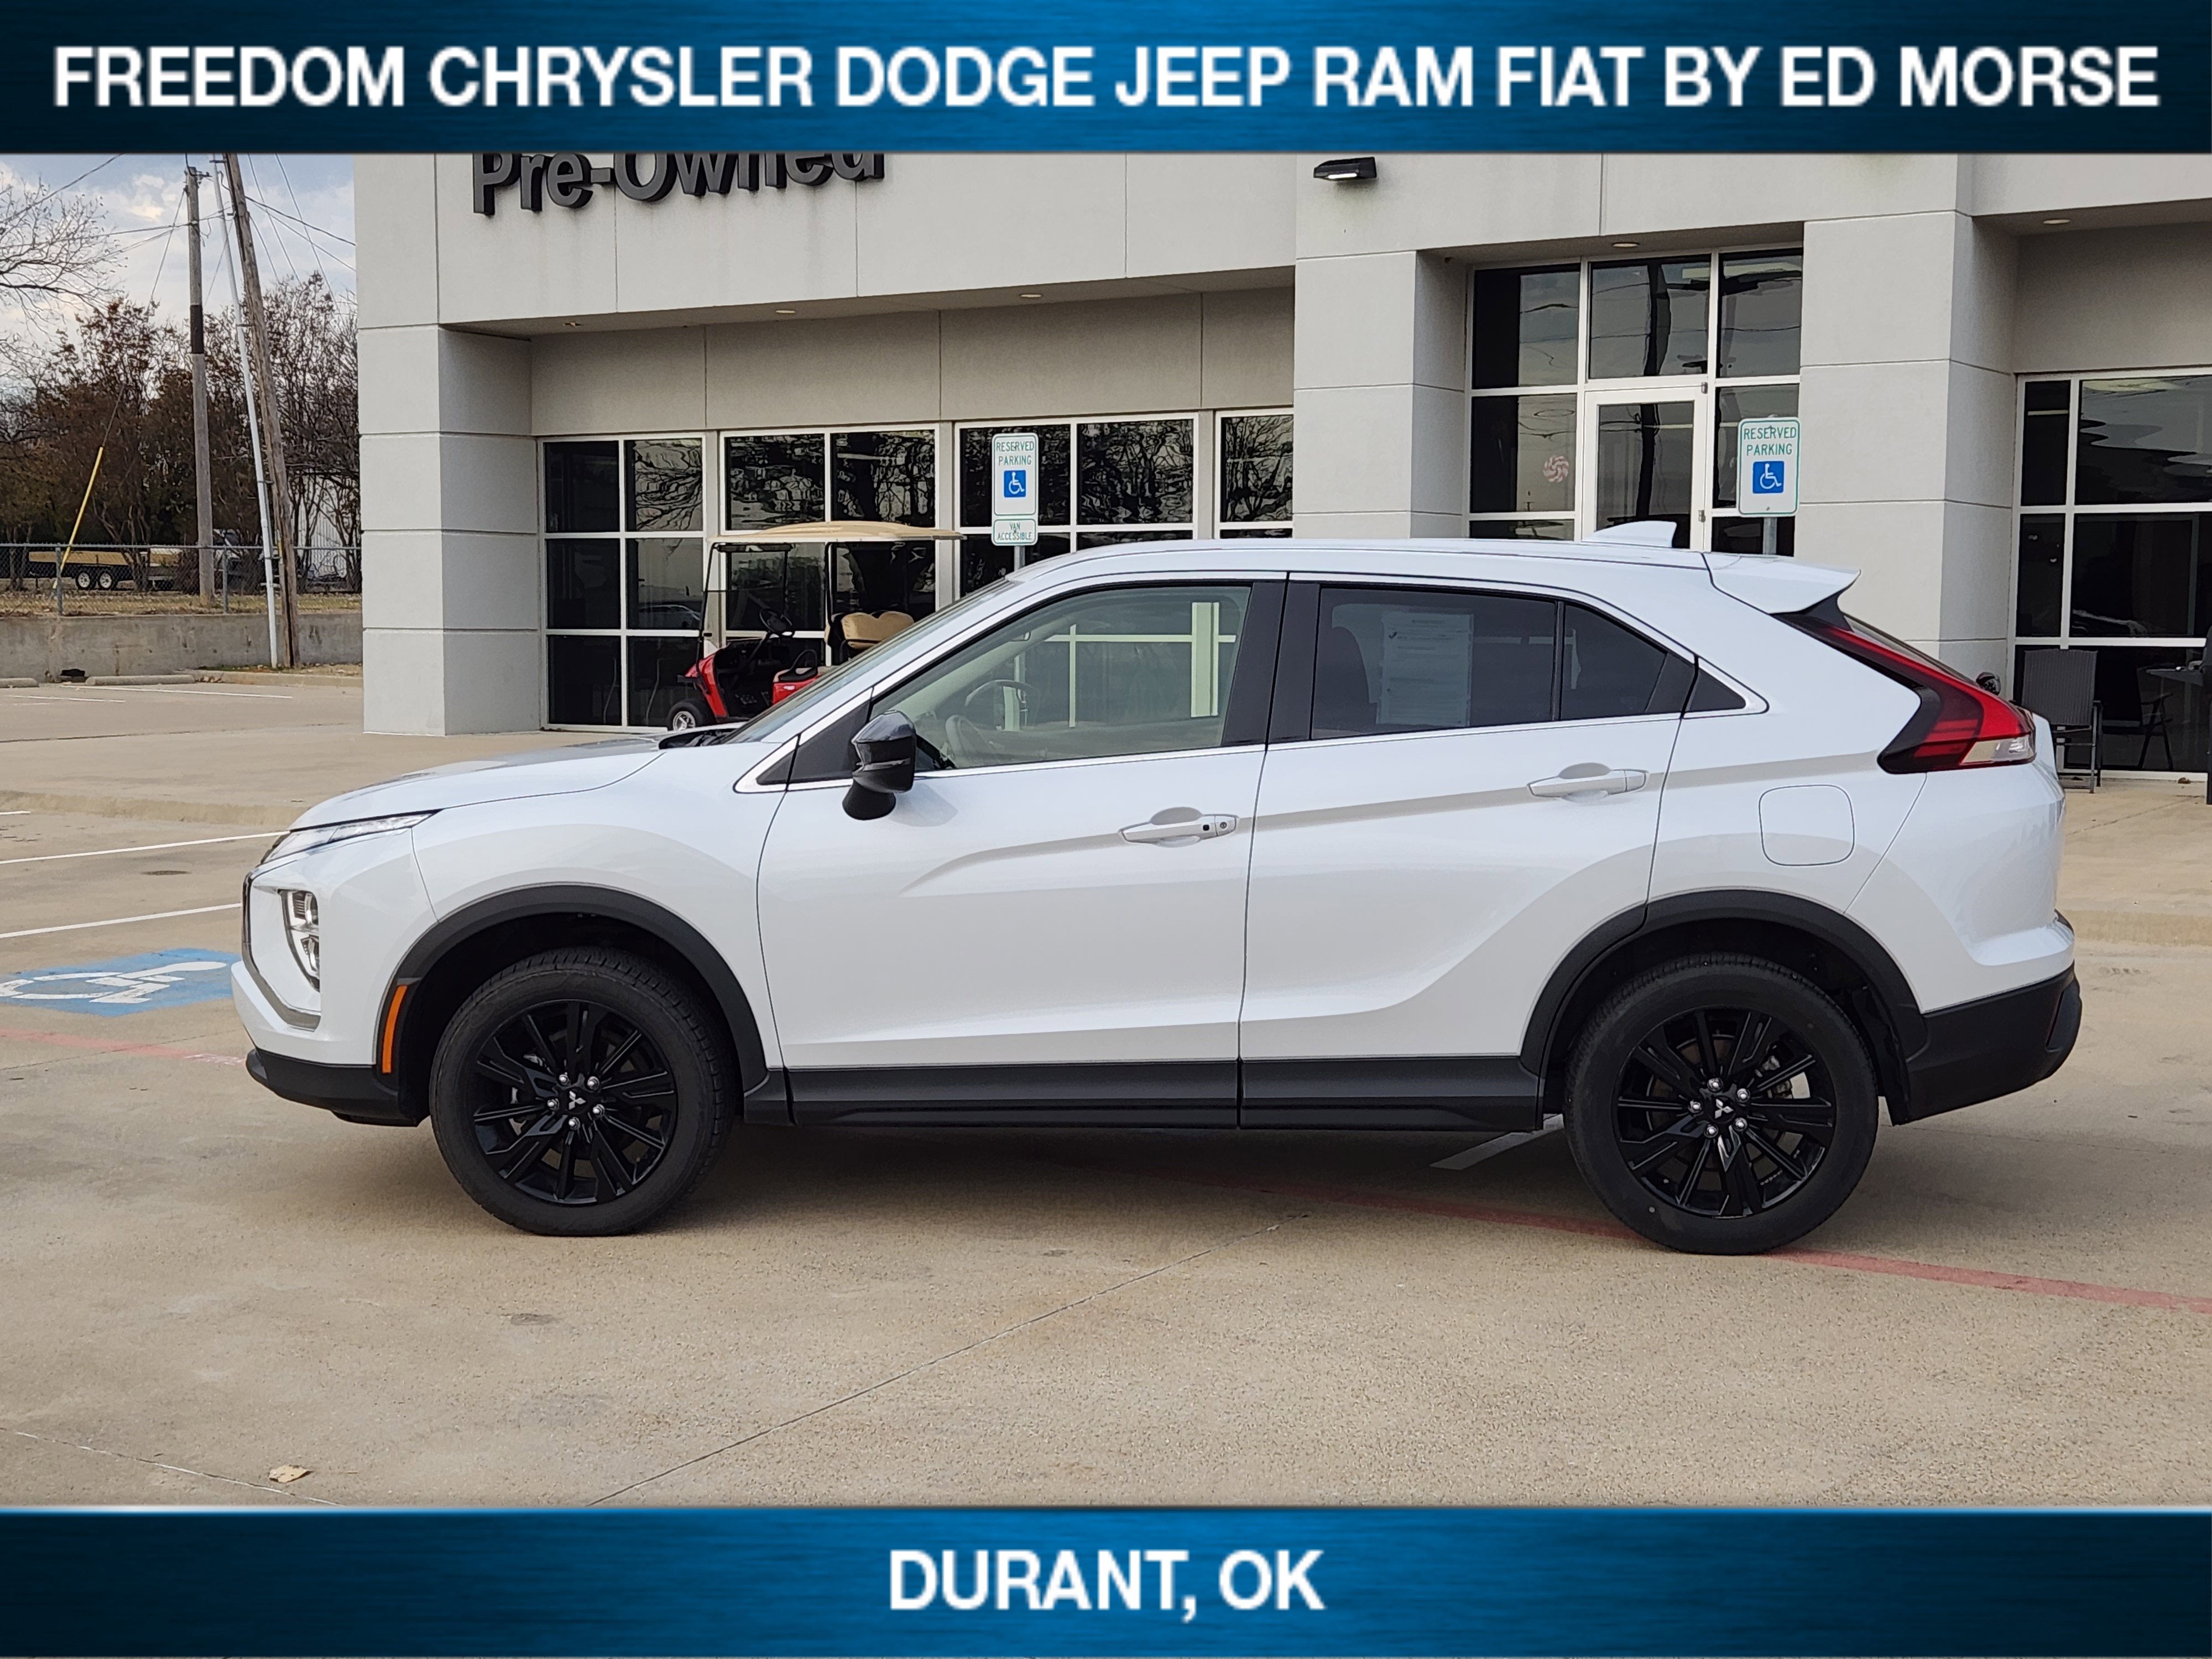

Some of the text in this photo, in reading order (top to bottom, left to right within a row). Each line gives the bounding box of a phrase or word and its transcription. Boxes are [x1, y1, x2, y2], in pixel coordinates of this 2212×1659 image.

[1743, 426, 1797, 440] RESERVED
[995, 441, 1035, 452] RESERVED
[1746, 443, 1793, 456] PARKING
[998, 455, 1032, 466] PARKING
[1009, 522, 1021, 530] VAN
[997, 532, 1032, 540] ACCESSIBLE
